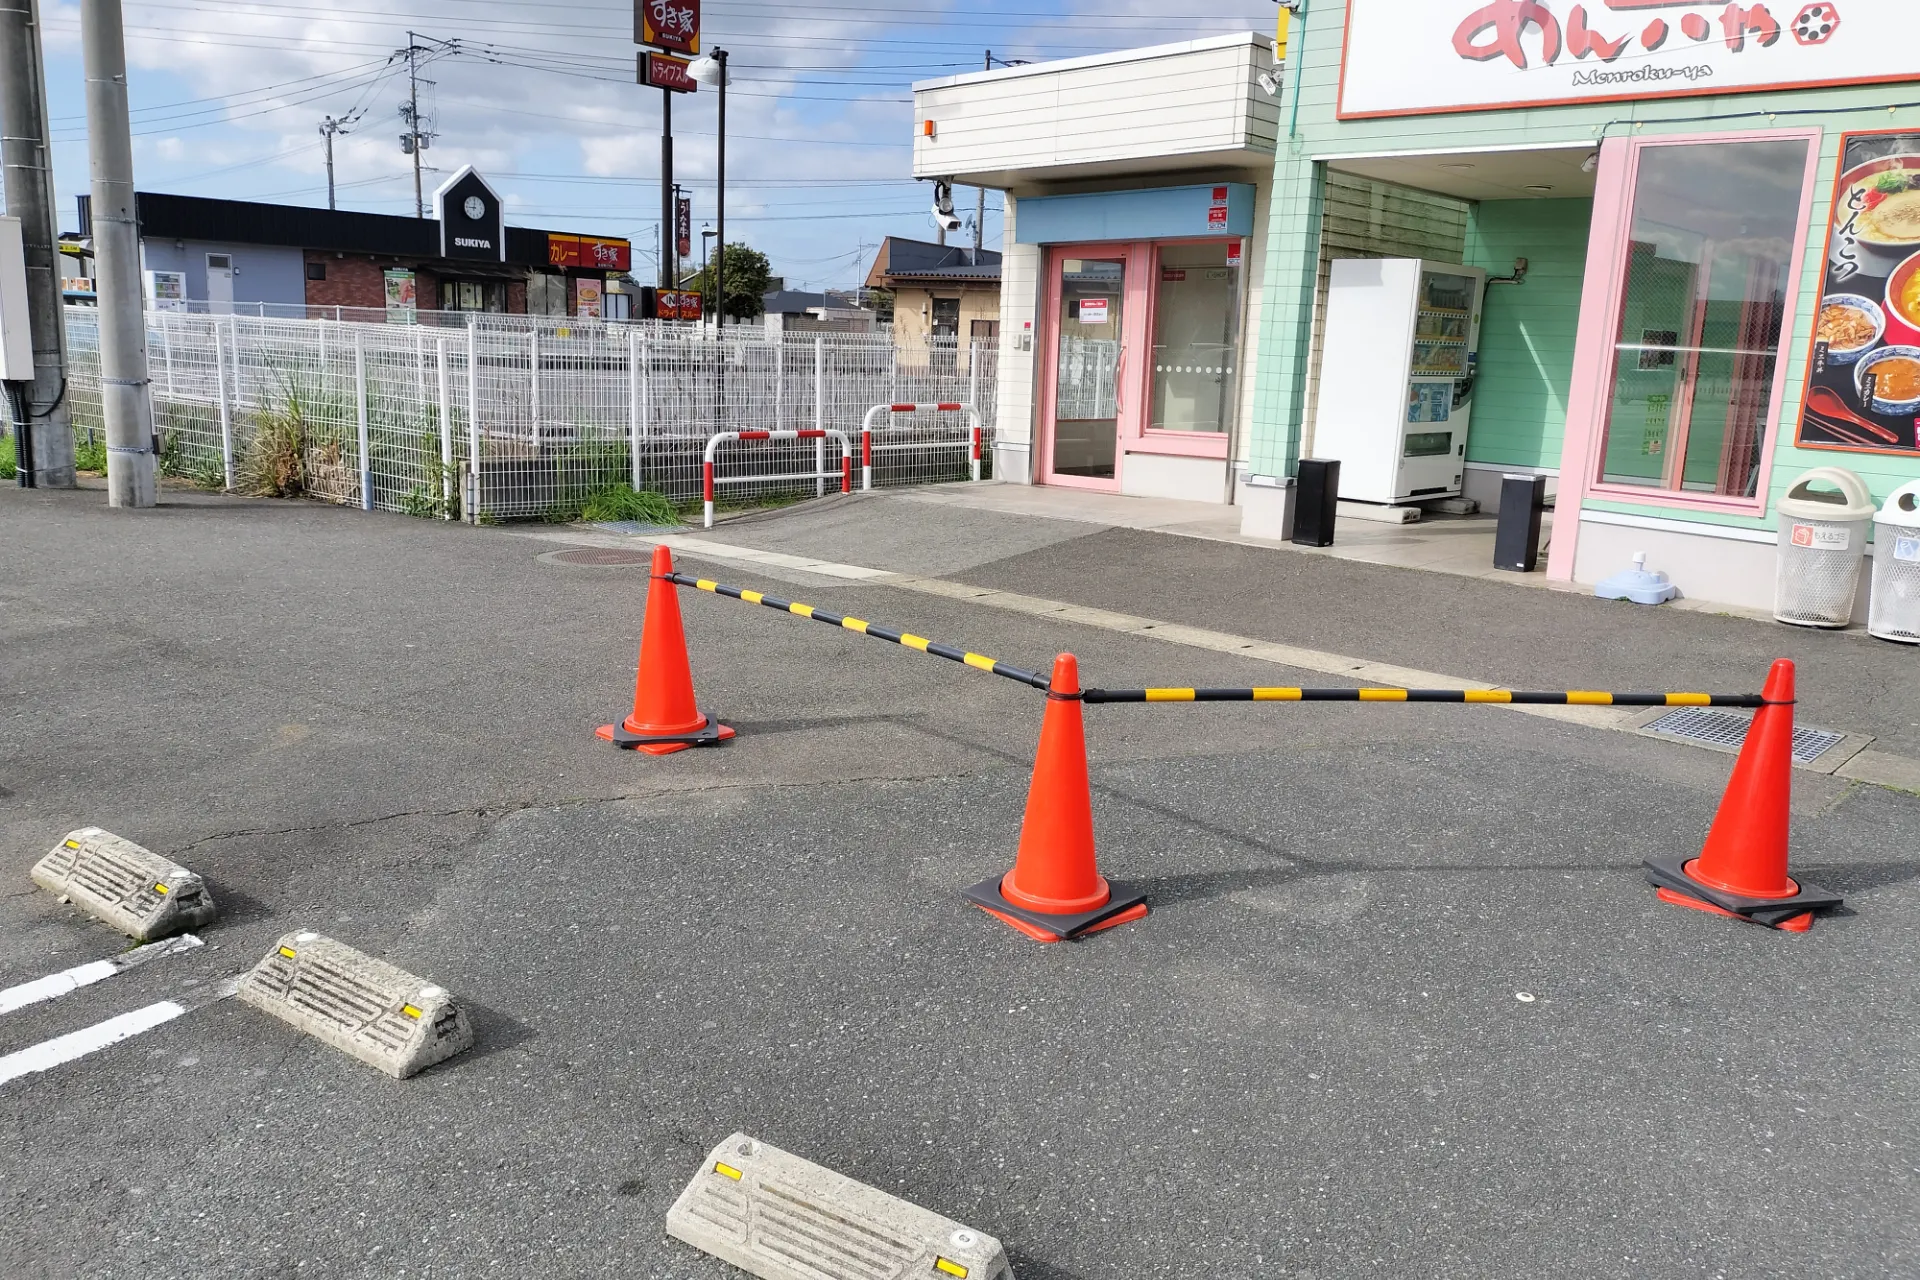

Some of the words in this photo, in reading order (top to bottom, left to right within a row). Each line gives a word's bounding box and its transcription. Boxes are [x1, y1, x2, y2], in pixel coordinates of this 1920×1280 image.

[650, 0, 694, 35] すき家
[661, 33, 682, 42] SUKIYA
[652, 61, 689, 83] ドライブスル
[1572, 64, 1713, 87] Menroku-ya
[454, 237, 491, 249] SUKIYA
[1834, 186, 1867, 280] とんこつ
[550, 242, 578, 262] カレー
[592, 241, 618, 263] すき家
[666, 296, 676, 304] IN
[679, 294, 698, 309] すき家
[658, 309, 701, 318] ドライスルー
